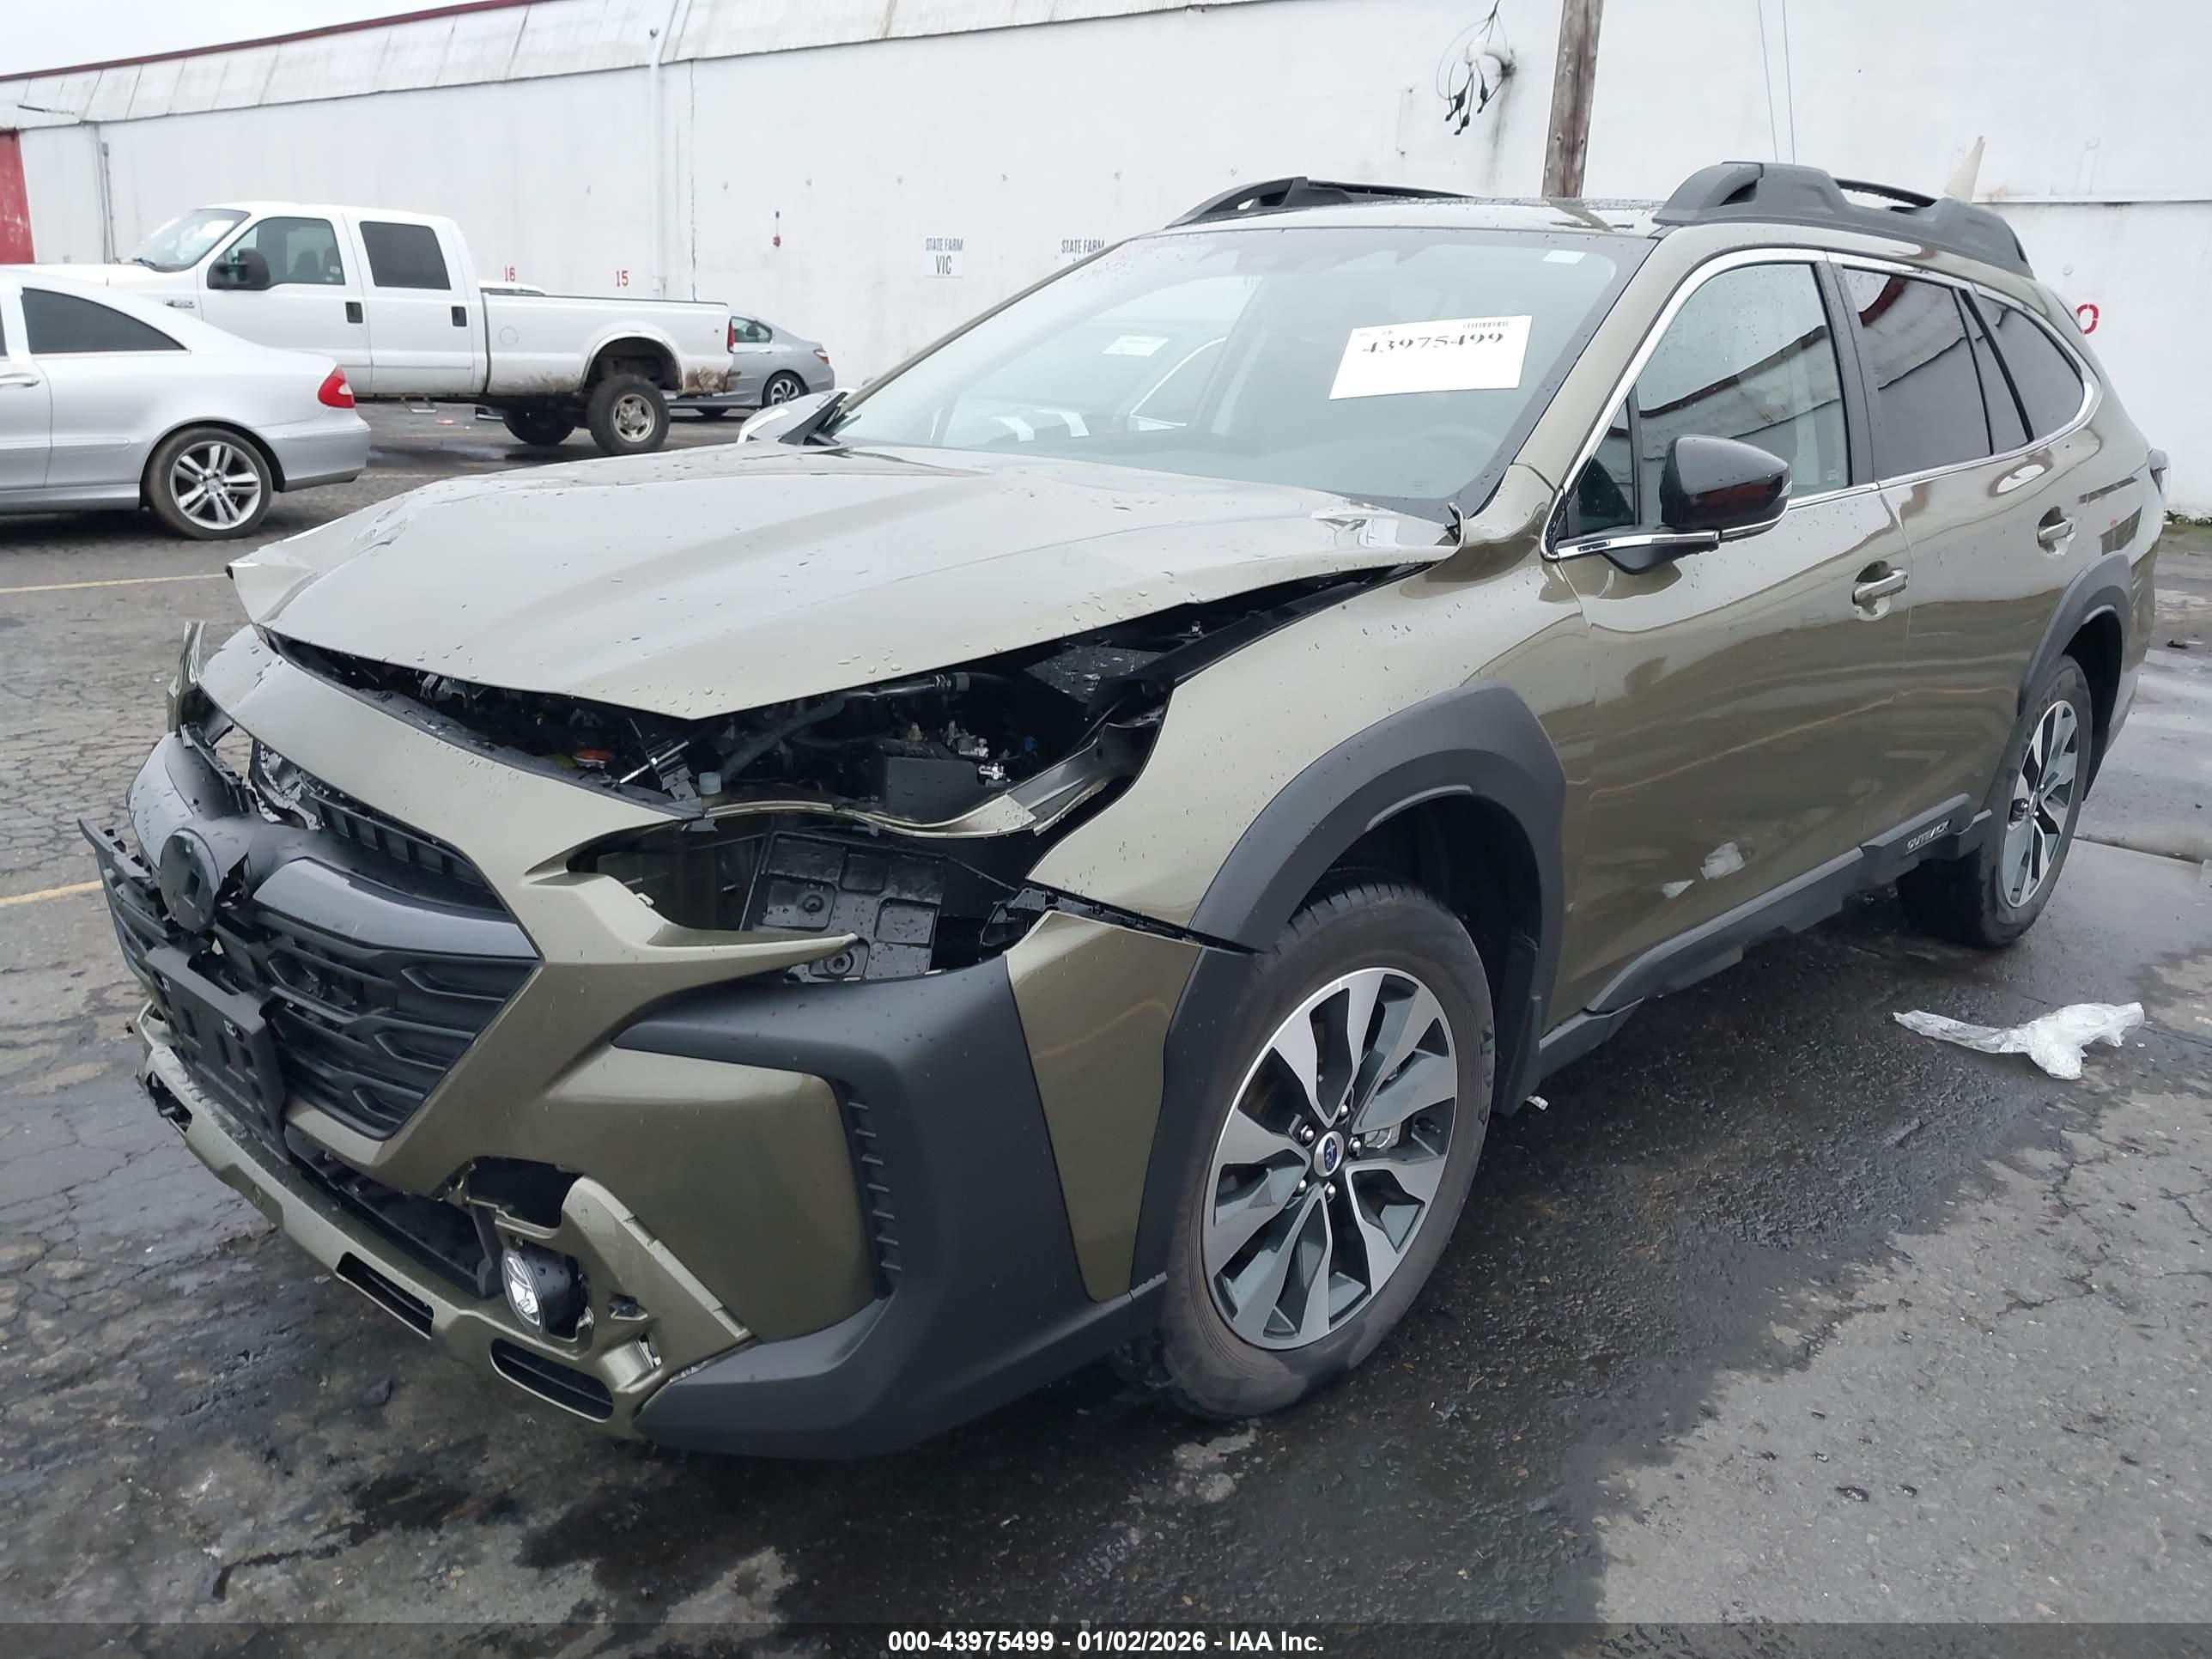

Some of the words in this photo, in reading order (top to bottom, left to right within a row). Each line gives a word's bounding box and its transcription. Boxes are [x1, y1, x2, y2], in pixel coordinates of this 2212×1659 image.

[1061, 240, 1083, 254] STATE
[936, 255, 952, 275] VIC
[504, 267, 516, 282] 16
[617, 270, 629, 288] 15
